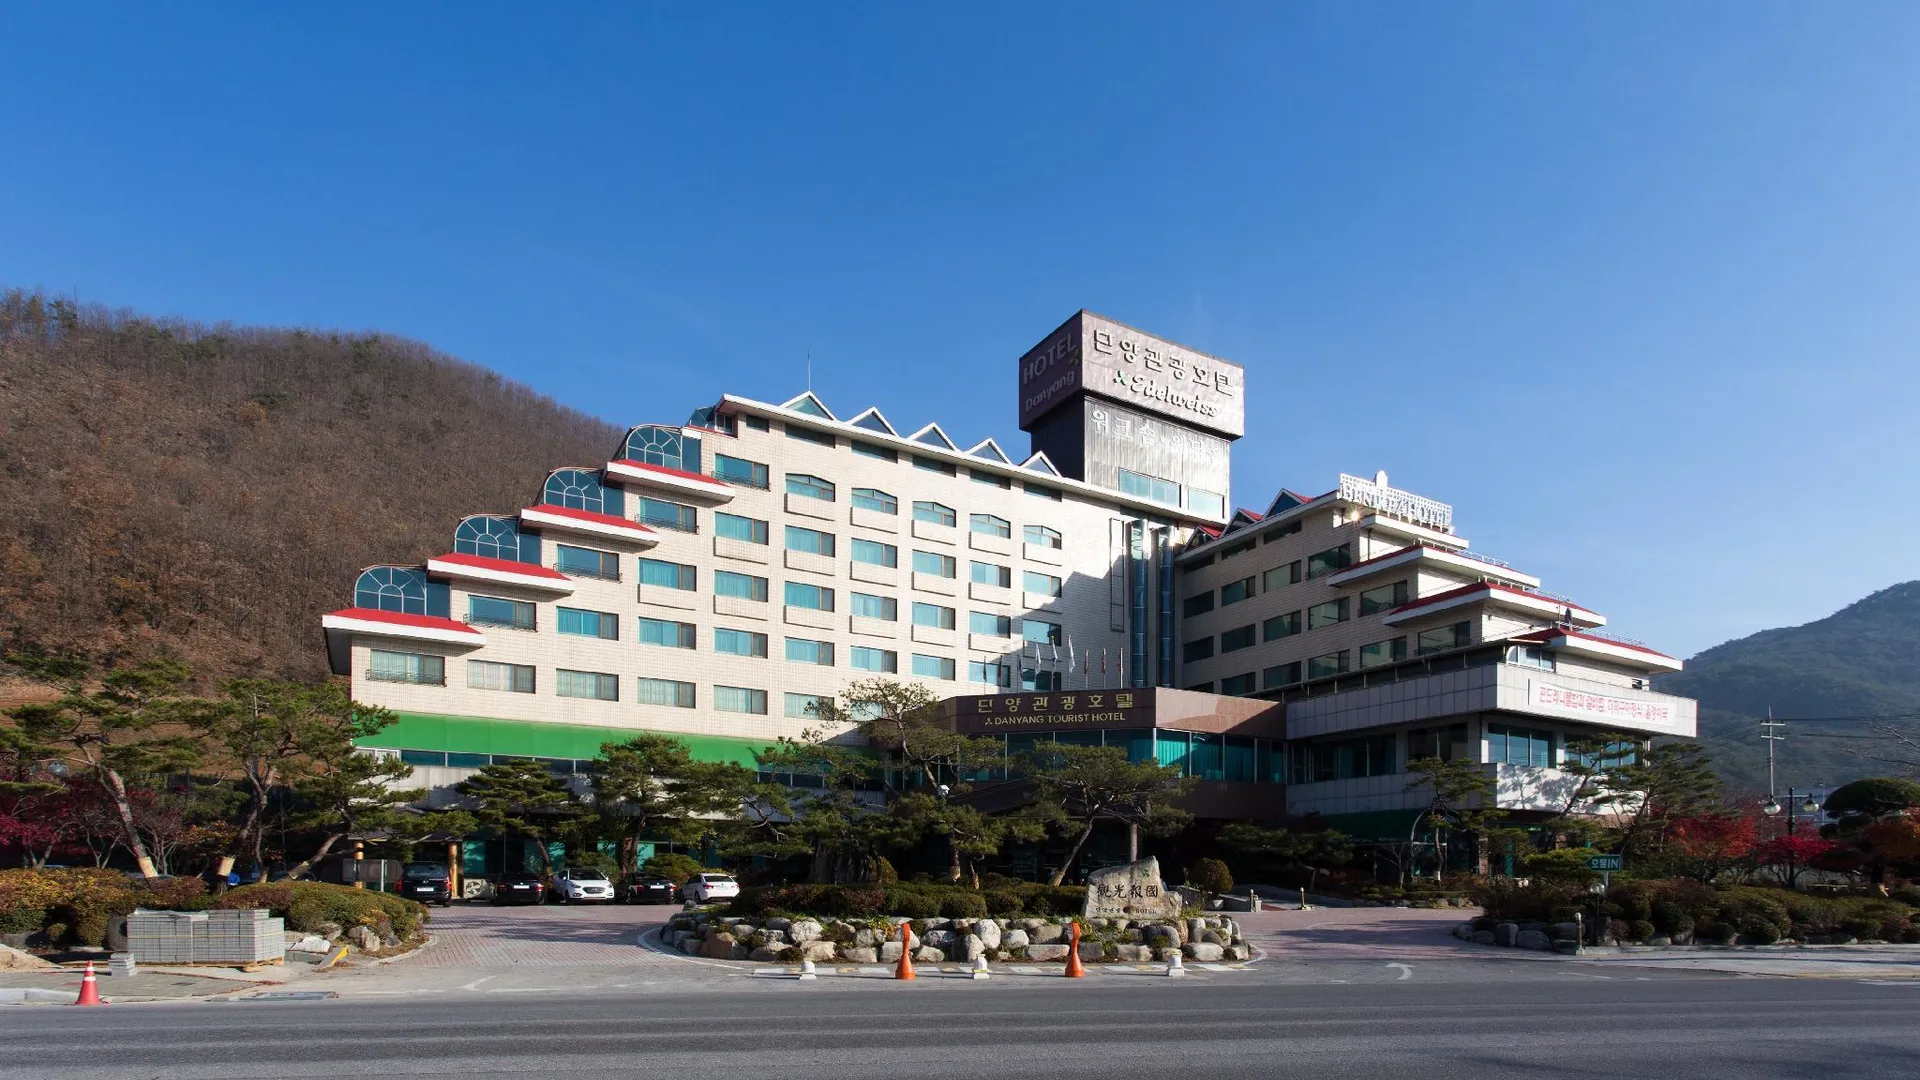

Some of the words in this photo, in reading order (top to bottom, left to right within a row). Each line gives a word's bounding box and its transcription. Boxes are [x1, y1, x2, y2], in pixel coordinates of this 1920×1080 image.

[1023, 332, 1077, 385] HOTEL
[1093, 328, 1236, 397] 단양관광호텔
[1025, 370, 1075, 413] Danyang
[1130, 373, 1219, 419] Edelweiss
[977, 693, 1134, 714] 단양관광호텔
[994, 716, 1045, 726] DANYANG
[1047, 714, 1090, 723] TOURIST
[1091, 712, 1126, 722] HOTEL
